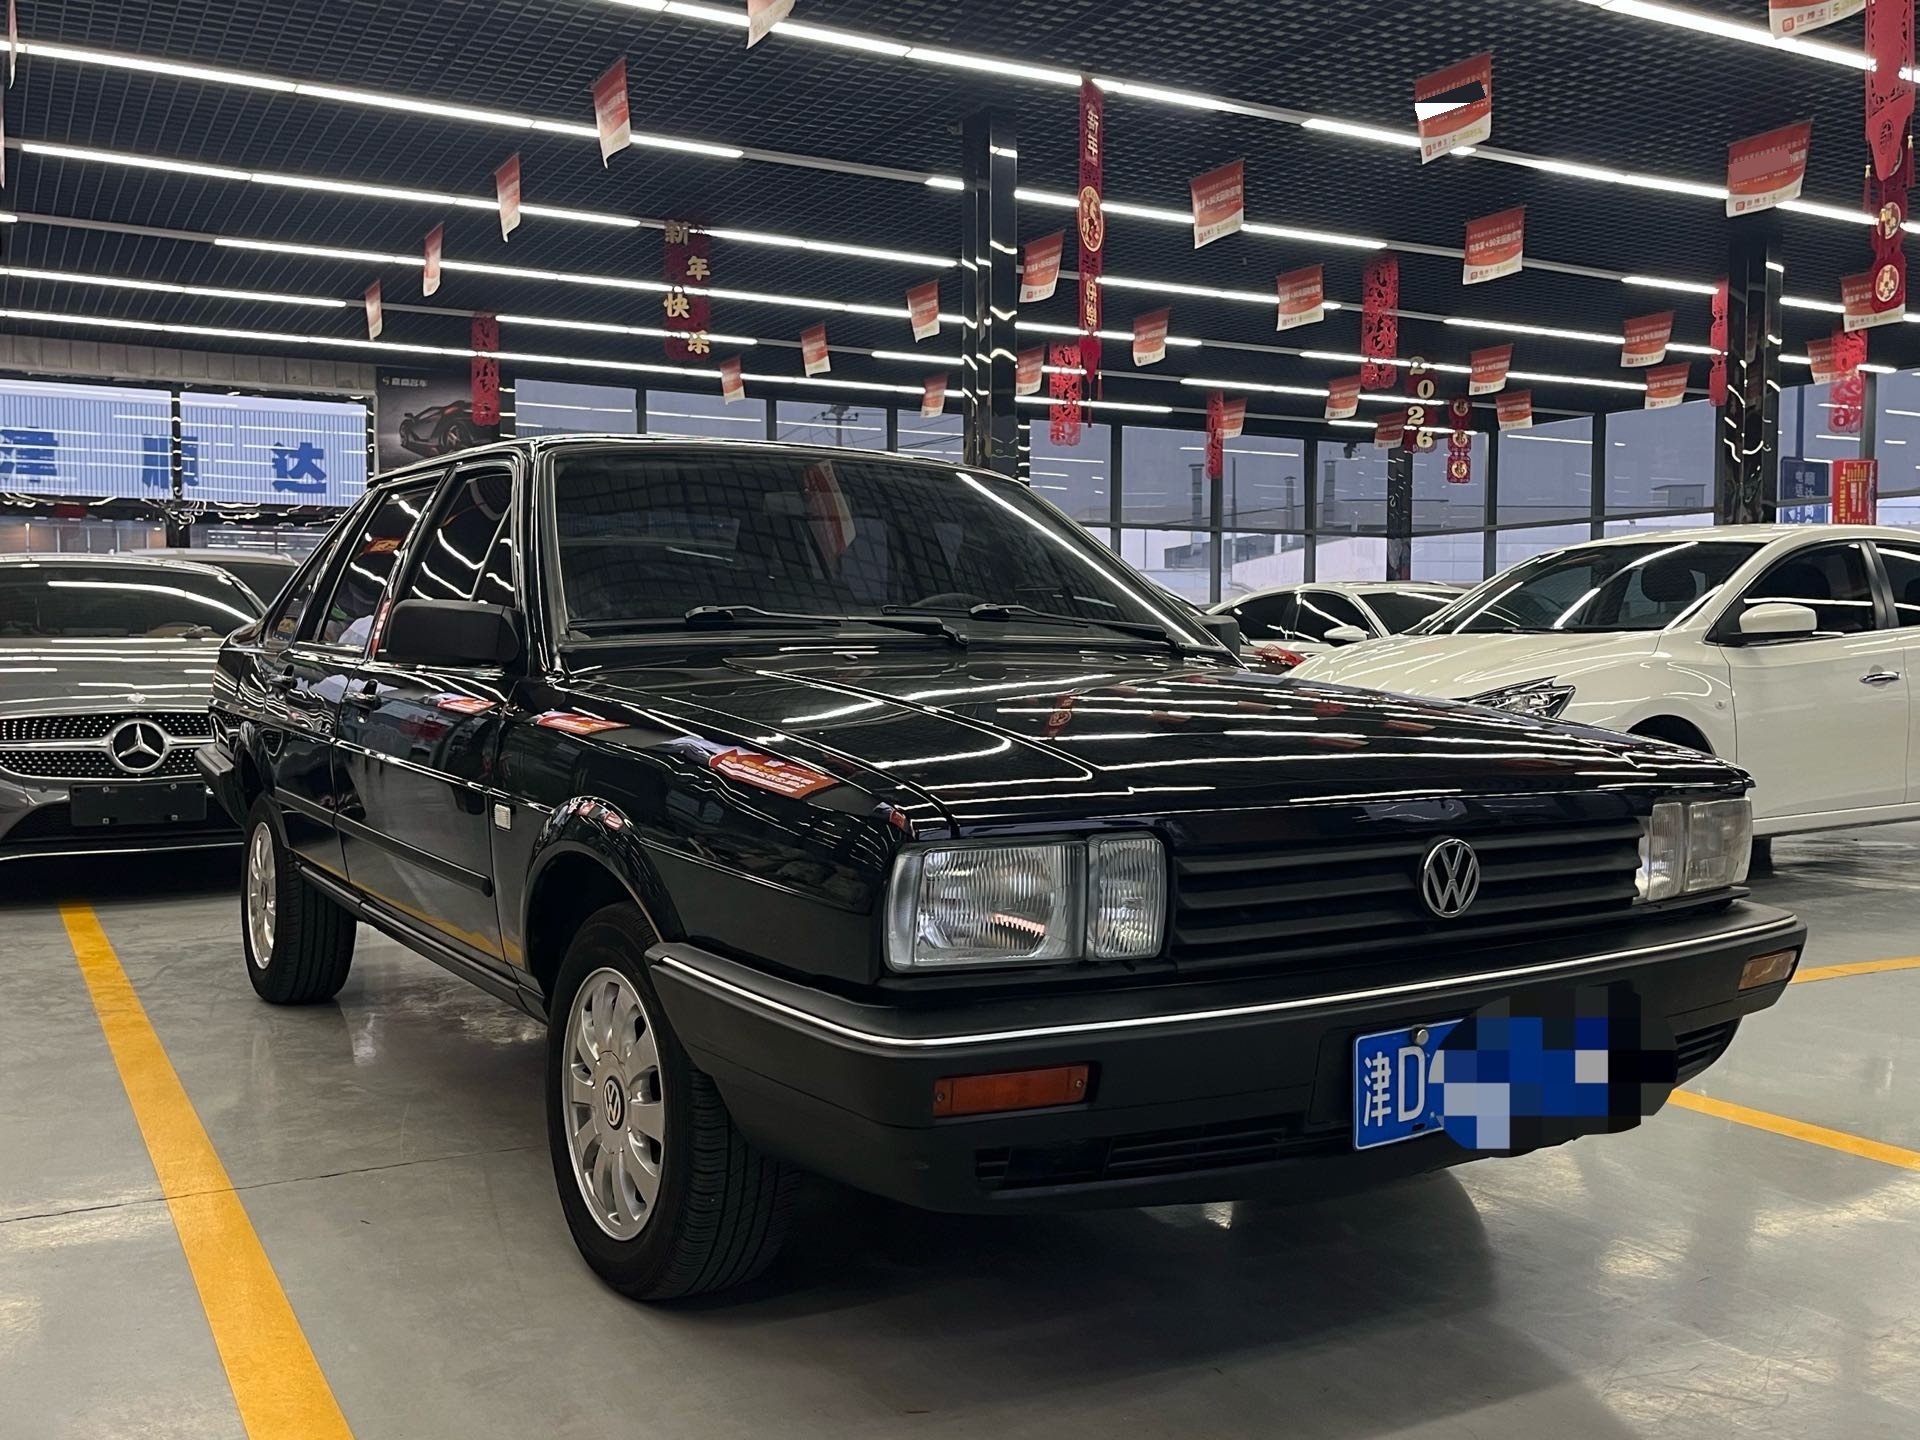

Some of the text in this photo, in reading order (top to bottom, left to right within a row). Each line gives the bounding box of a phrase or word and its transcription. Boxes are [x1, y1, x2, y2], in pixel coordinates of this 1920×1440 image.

[663, 219, 710, 355] 新年快乐
[1407, 356, 1435, 449] 2026
